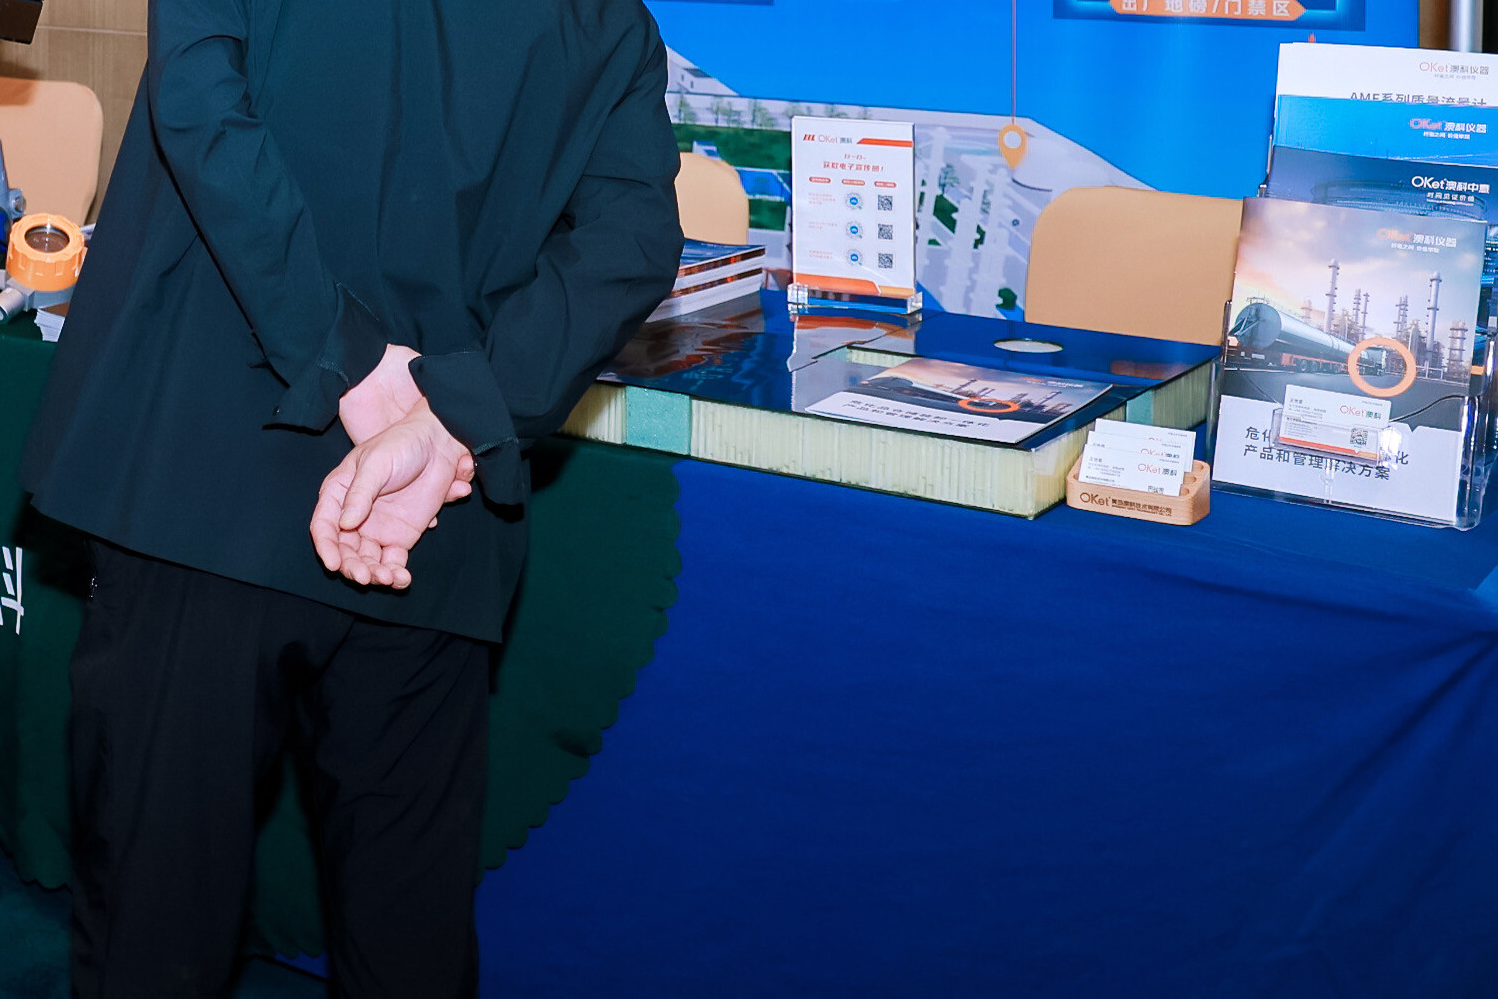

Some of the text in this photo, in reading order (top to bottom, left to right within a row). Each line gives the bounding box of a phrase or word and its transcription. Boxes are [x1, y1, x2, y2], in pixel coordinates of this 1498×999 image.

[1419, 61, 1449, 73] OKet
[1411, 175, 1445, 190] OKet
[1339, 405, 1364, 418] OKet
[1138, 463, 1162, 475] OKet
[1080, 492, 1110, 507] OKet
